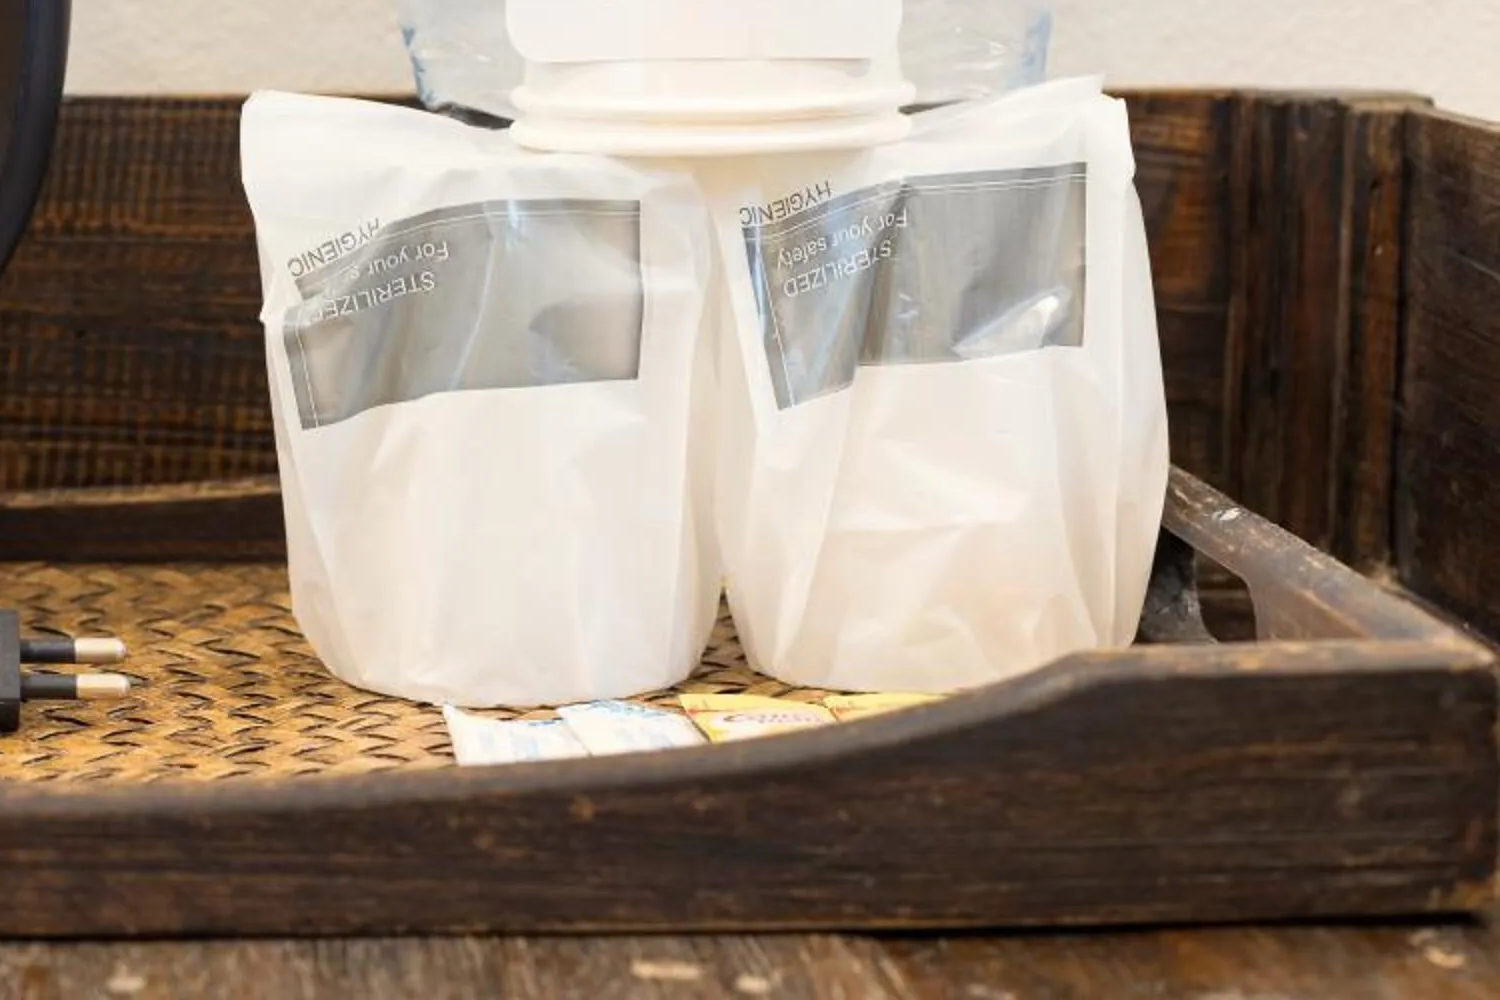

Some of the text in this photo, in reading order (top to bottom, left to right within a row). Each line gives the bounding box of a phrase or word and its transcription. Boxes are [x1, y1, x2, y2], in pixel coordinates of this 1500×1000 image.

[739, 180, 832, 226] HYGIENIC
[366, 241, 450, 276] For your
[777, 207, 908, 271] For your safety
[783, 239, 891, 298] STERILIZED
